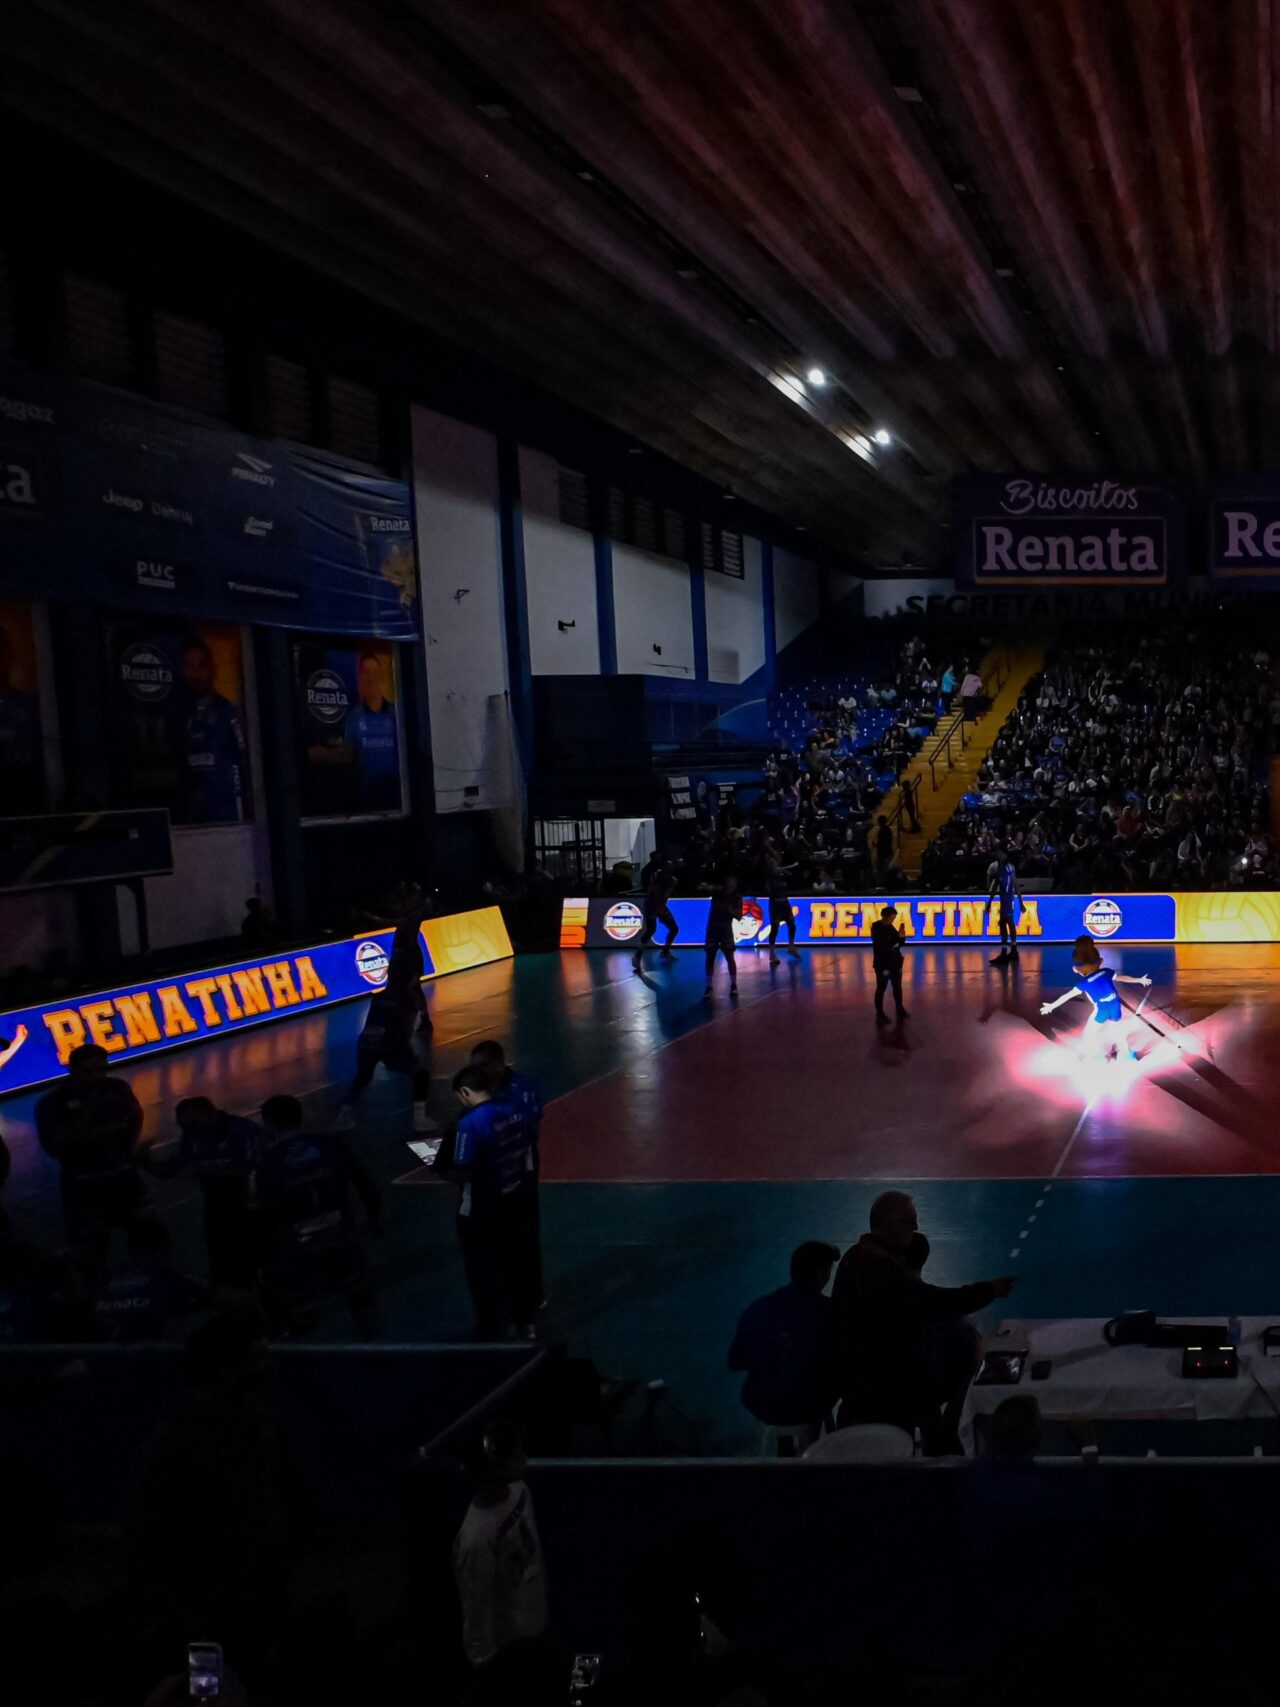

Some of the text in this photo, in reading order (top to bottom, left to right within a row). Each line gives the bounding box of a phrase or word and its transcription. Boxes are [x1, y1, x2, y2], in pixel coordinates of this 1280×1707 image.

[1000, 479, 1139, 515] Biscoitos
[370, 516, 411, 532] Renata
[981, 525, 1159, 572] Renata
[136, 560, 176, 580] PUC
[119, 664, 174, 684] Renata
[306, 688, 350, 706] Renata
[43, 956, 328, 1065] RENATINHA
